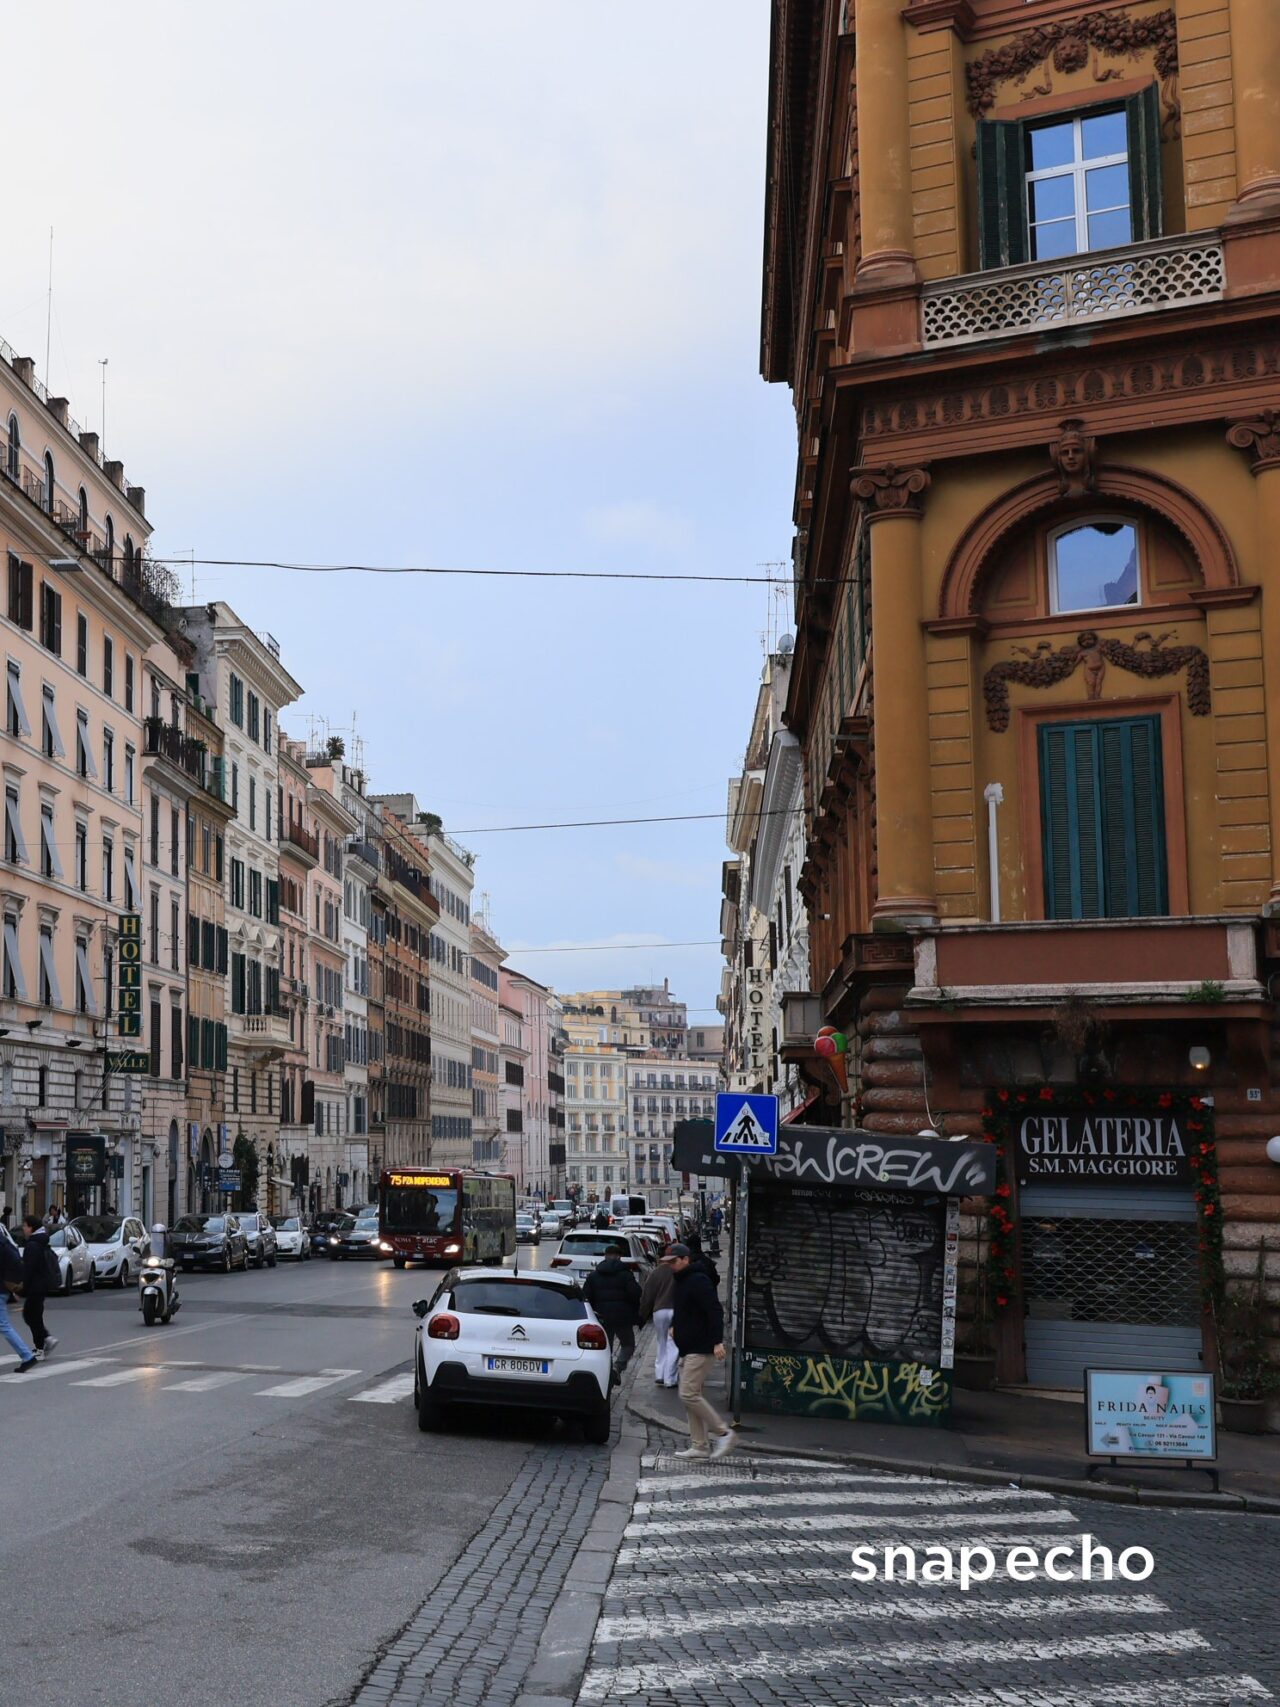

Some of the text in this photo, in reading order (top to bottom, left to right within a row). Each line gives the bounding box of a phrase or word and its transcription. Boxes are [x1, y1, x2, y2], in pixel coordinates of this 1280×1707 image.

[122, 917, 138, 1034] HOTEL
[749, 969, 764, 1068] HOTEL
[1020, 1116, 1186, 1157] GELATERIA
[1029, 1158, 1178, 1176] S.M. MAGGIORE
[390, 1175, 402, 1185] 75
[494, 1359, 541, 1372] GR 806DV
[1097, 1401, 1206, 1414] FRIDA NAILS
